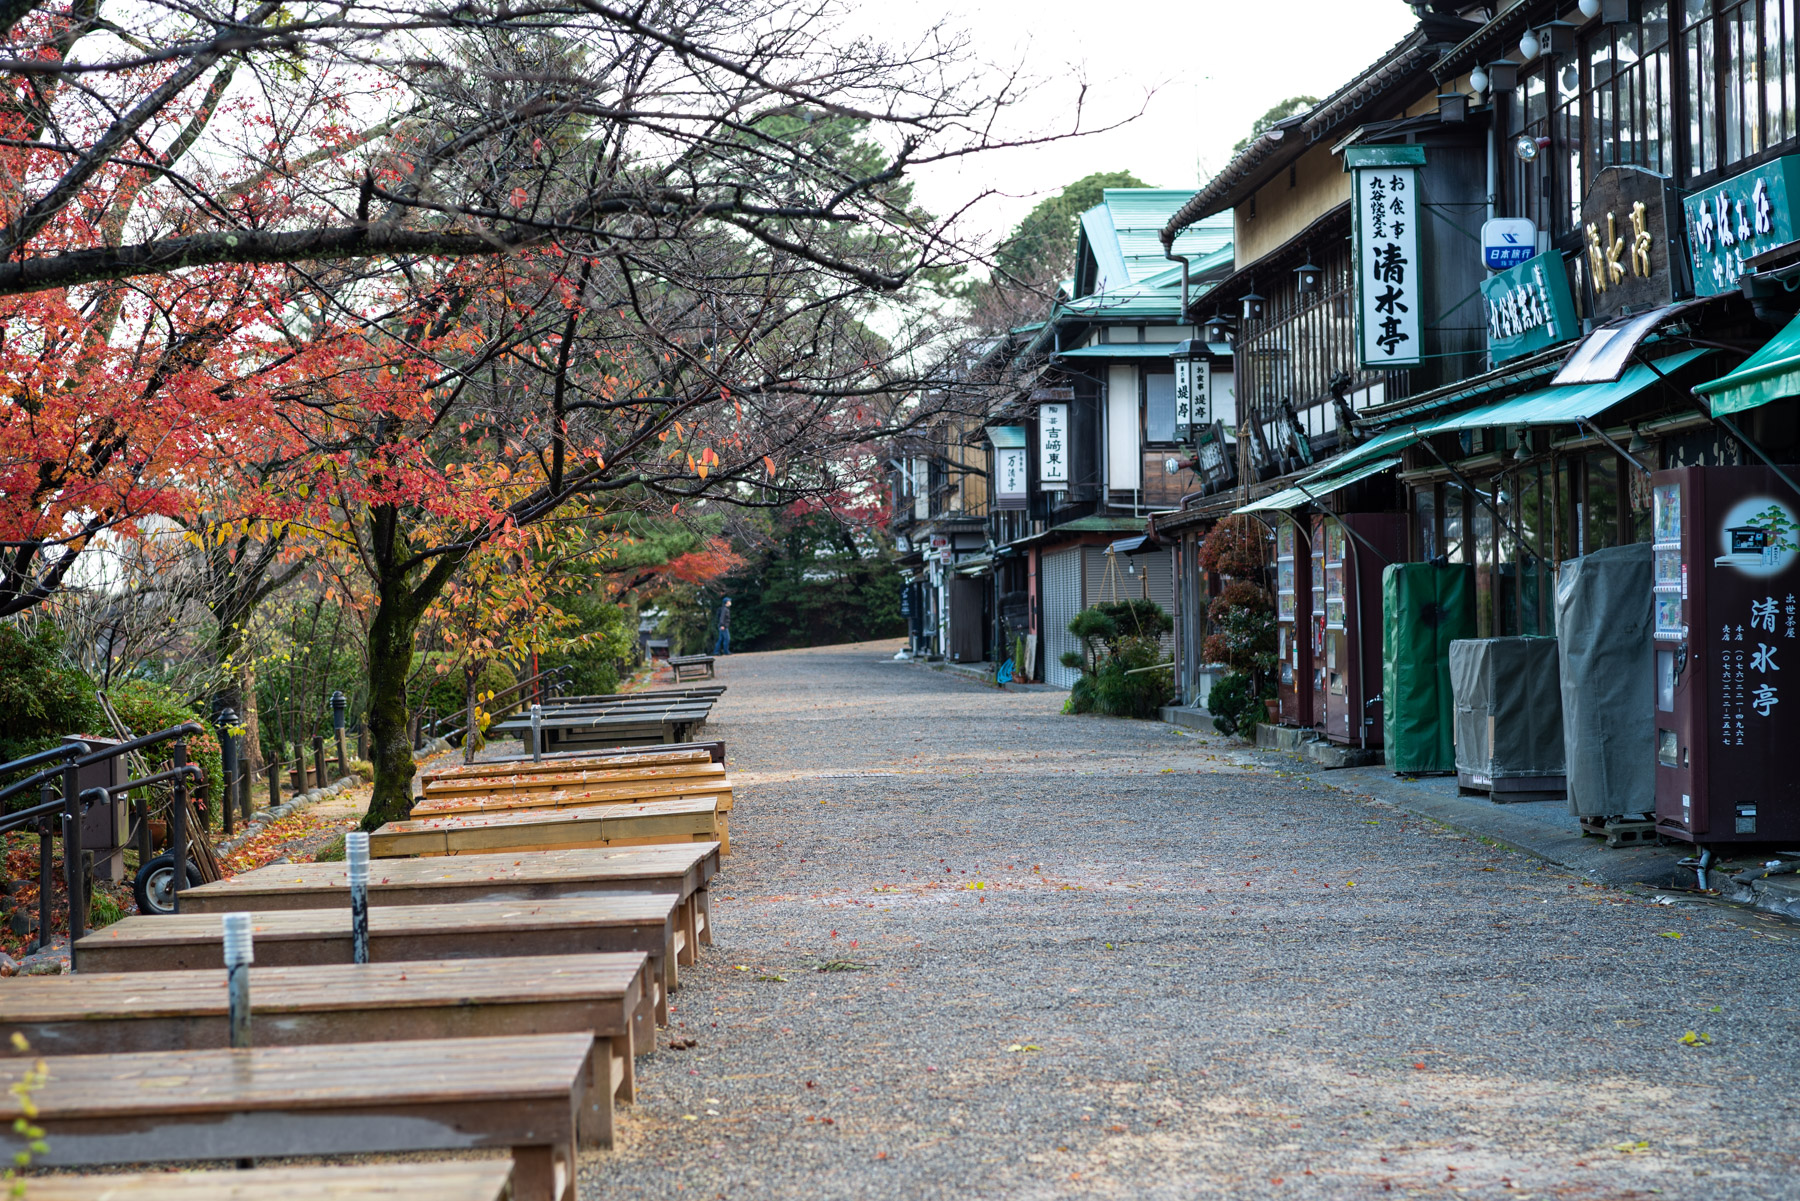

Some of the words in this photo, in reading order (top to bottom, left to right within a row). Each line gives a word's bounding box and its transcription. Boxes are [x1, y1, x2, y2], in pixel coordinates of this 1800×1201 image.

[1389, 174, 1405, 240] お食事
[1490, 248, 1531, 259] 日本旅行
[1372, 243, 1410, 356] 清水亭
[1177, 384, 1189, 419] 堤亭
[1194, 394, 1207, 419] 堤亭
[1721, 624, 1731, 642] 売店
[1734, 624, 1745, 642] 本店
[1784, 593, 1797, 639] 出世茶屋
[1749, 596, 1780, 718] 清水亭
